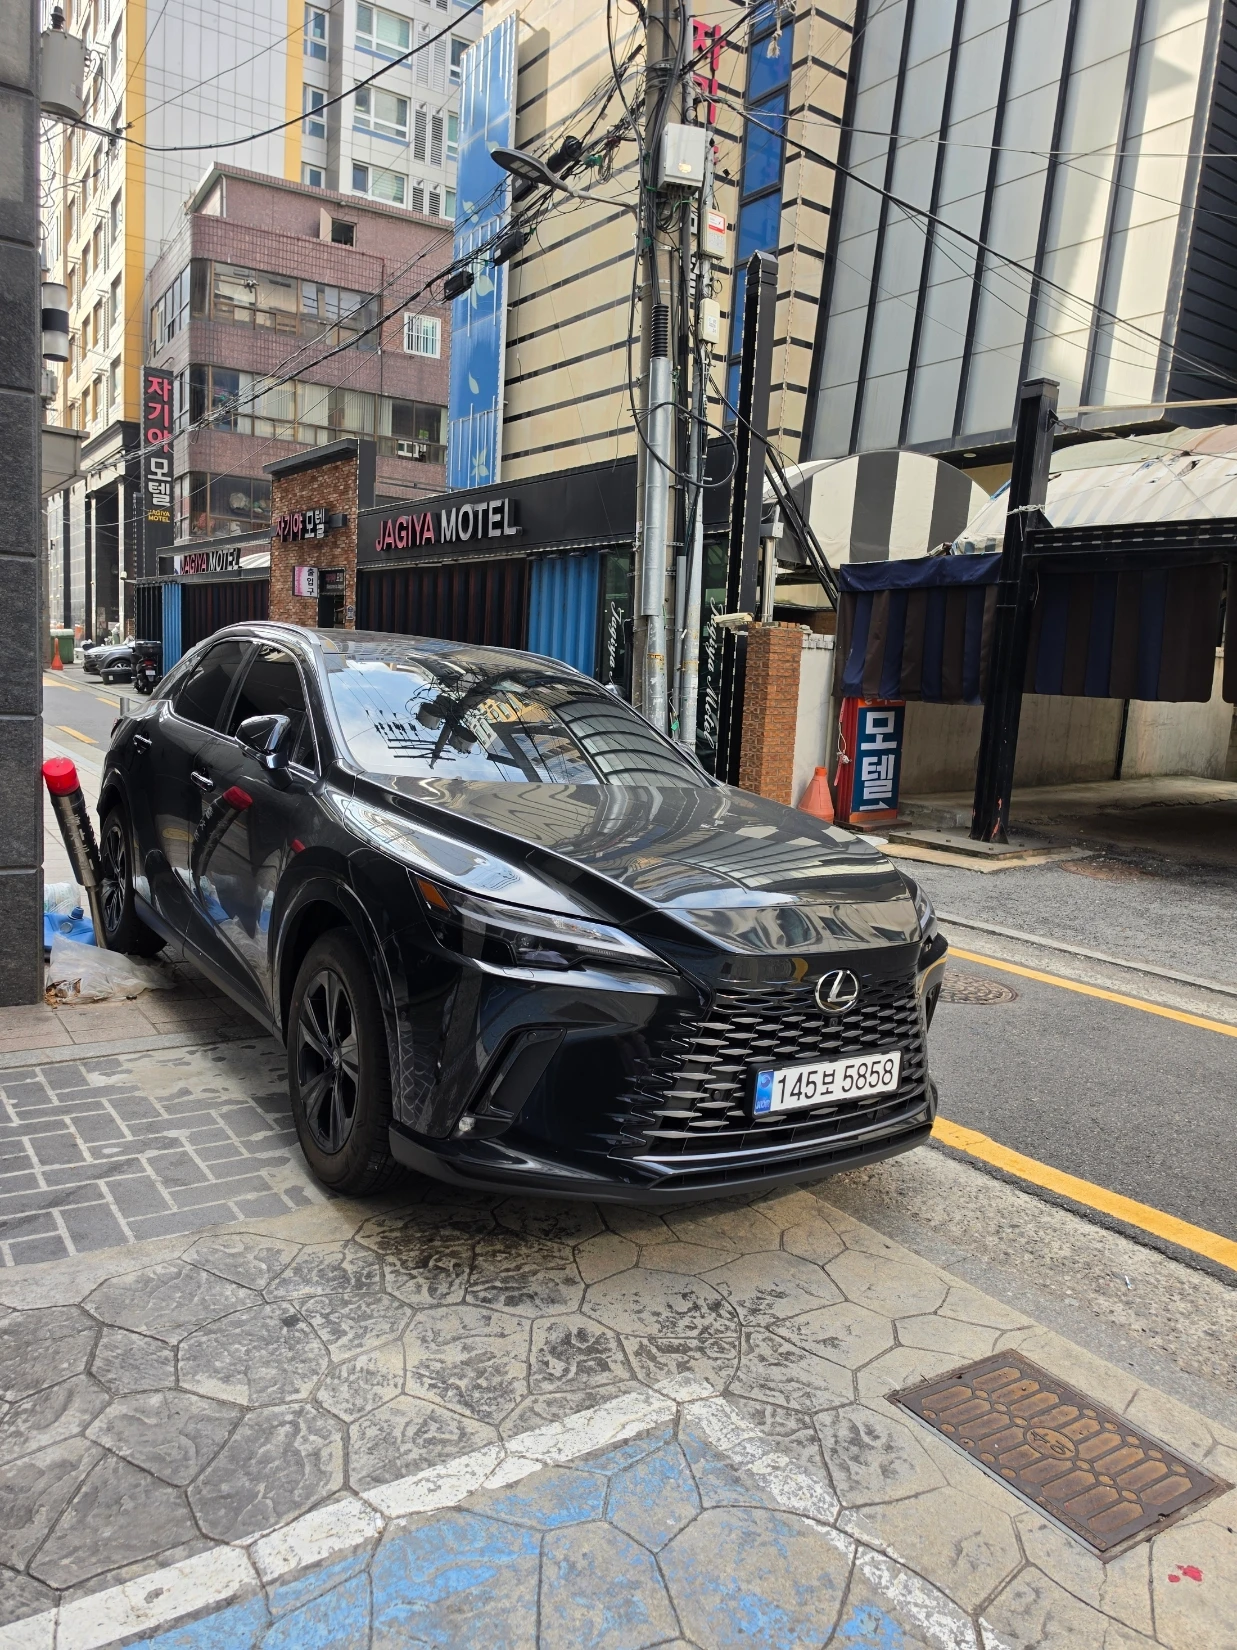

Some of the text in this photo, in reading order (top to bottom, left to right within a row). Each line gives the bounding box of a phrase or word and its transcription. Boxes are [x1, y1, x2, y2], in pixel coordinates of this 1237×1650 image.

[147, 376, 172, 507] 자기야 모텔
[148, 515, 171, 523] MOTEL
[275, 508, 325, 543] 자기야 모텔
[375, 497, 522, 552] JAGIYA MOTEL
[181, 548, 240, 575] JAGIYA MOTEL
[306, 567, 315, 596] 출입구
[607, 601, 624, 669] Jagiya
[703, 597, 724, 749] Jagiya Motel
[860, 711, 897, 800] 모텔
[841, 1058, 894, 1093] 5858
